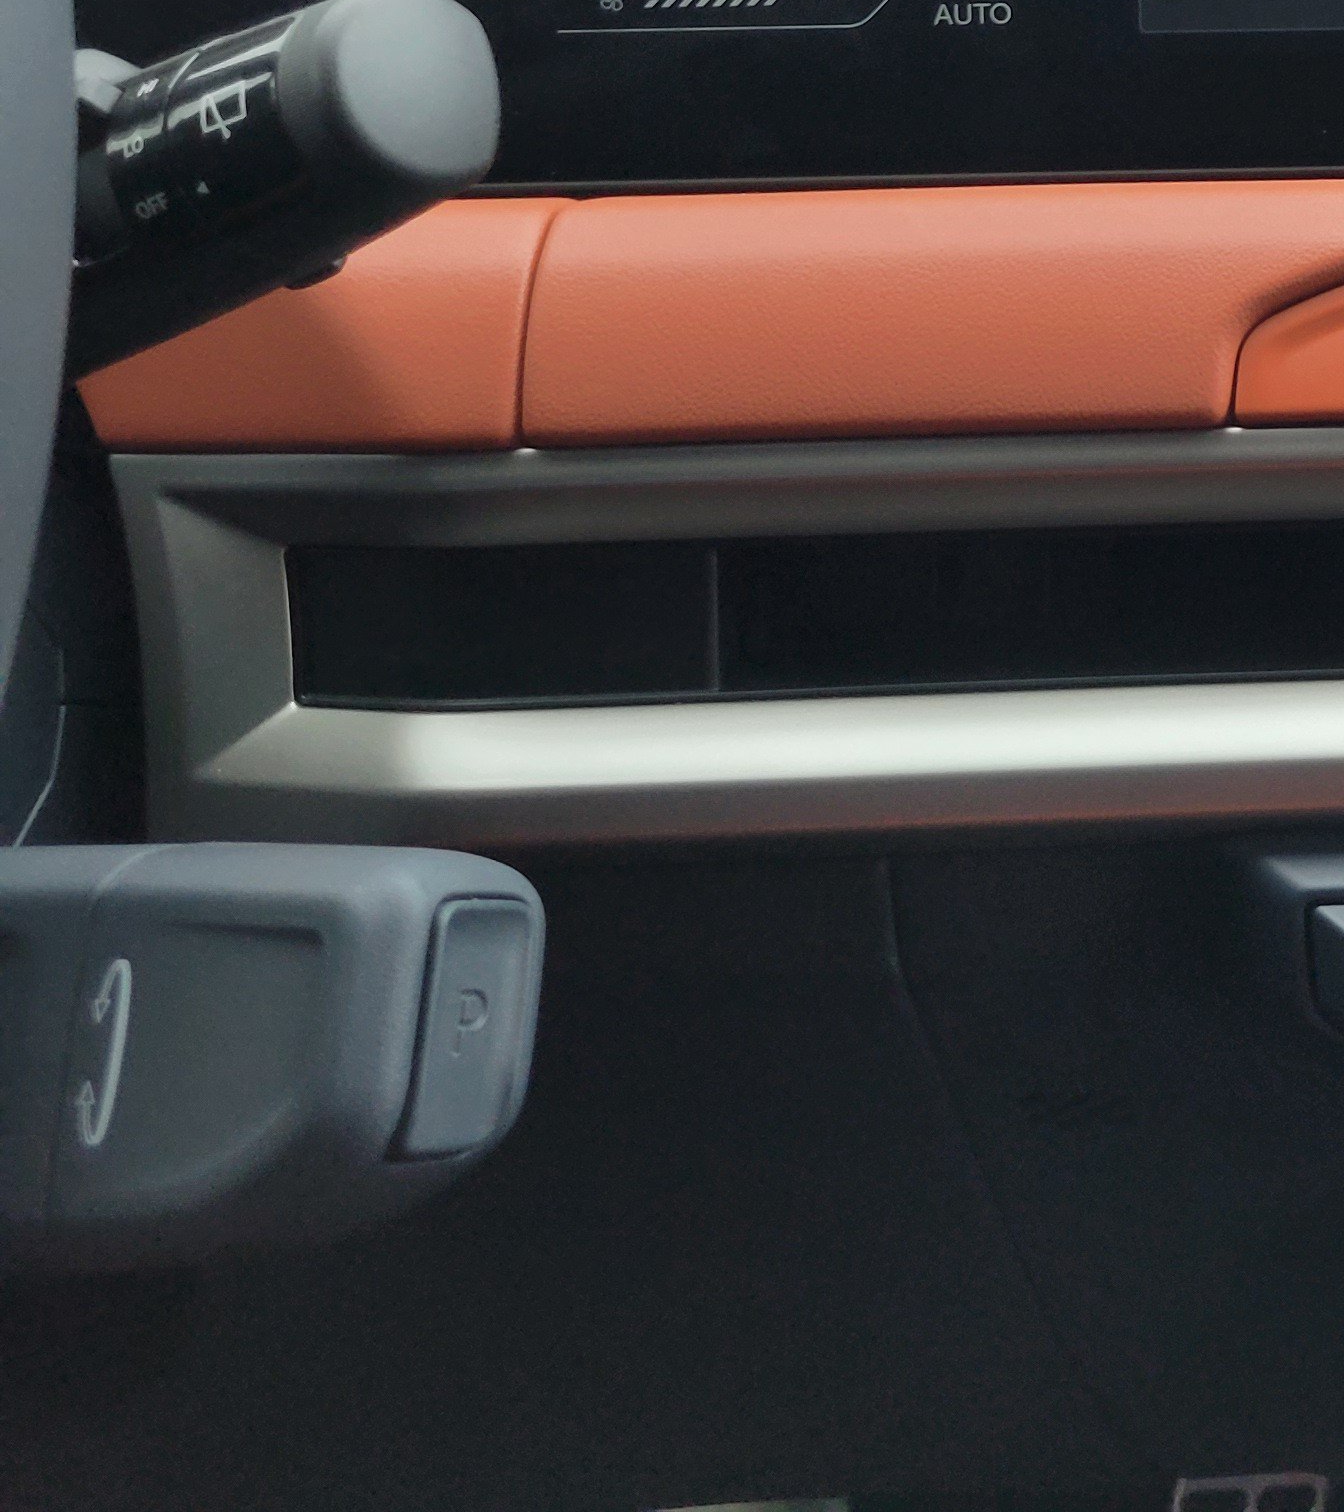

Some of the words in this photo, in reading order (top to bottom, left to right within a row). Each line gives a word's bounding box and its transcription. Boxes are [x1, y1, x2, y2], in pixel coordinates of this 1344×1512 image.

[933, 2, 1012, 26] AUTO
[134, 192, 168, 219] OFF
[450, 987, 489, 1058] P
